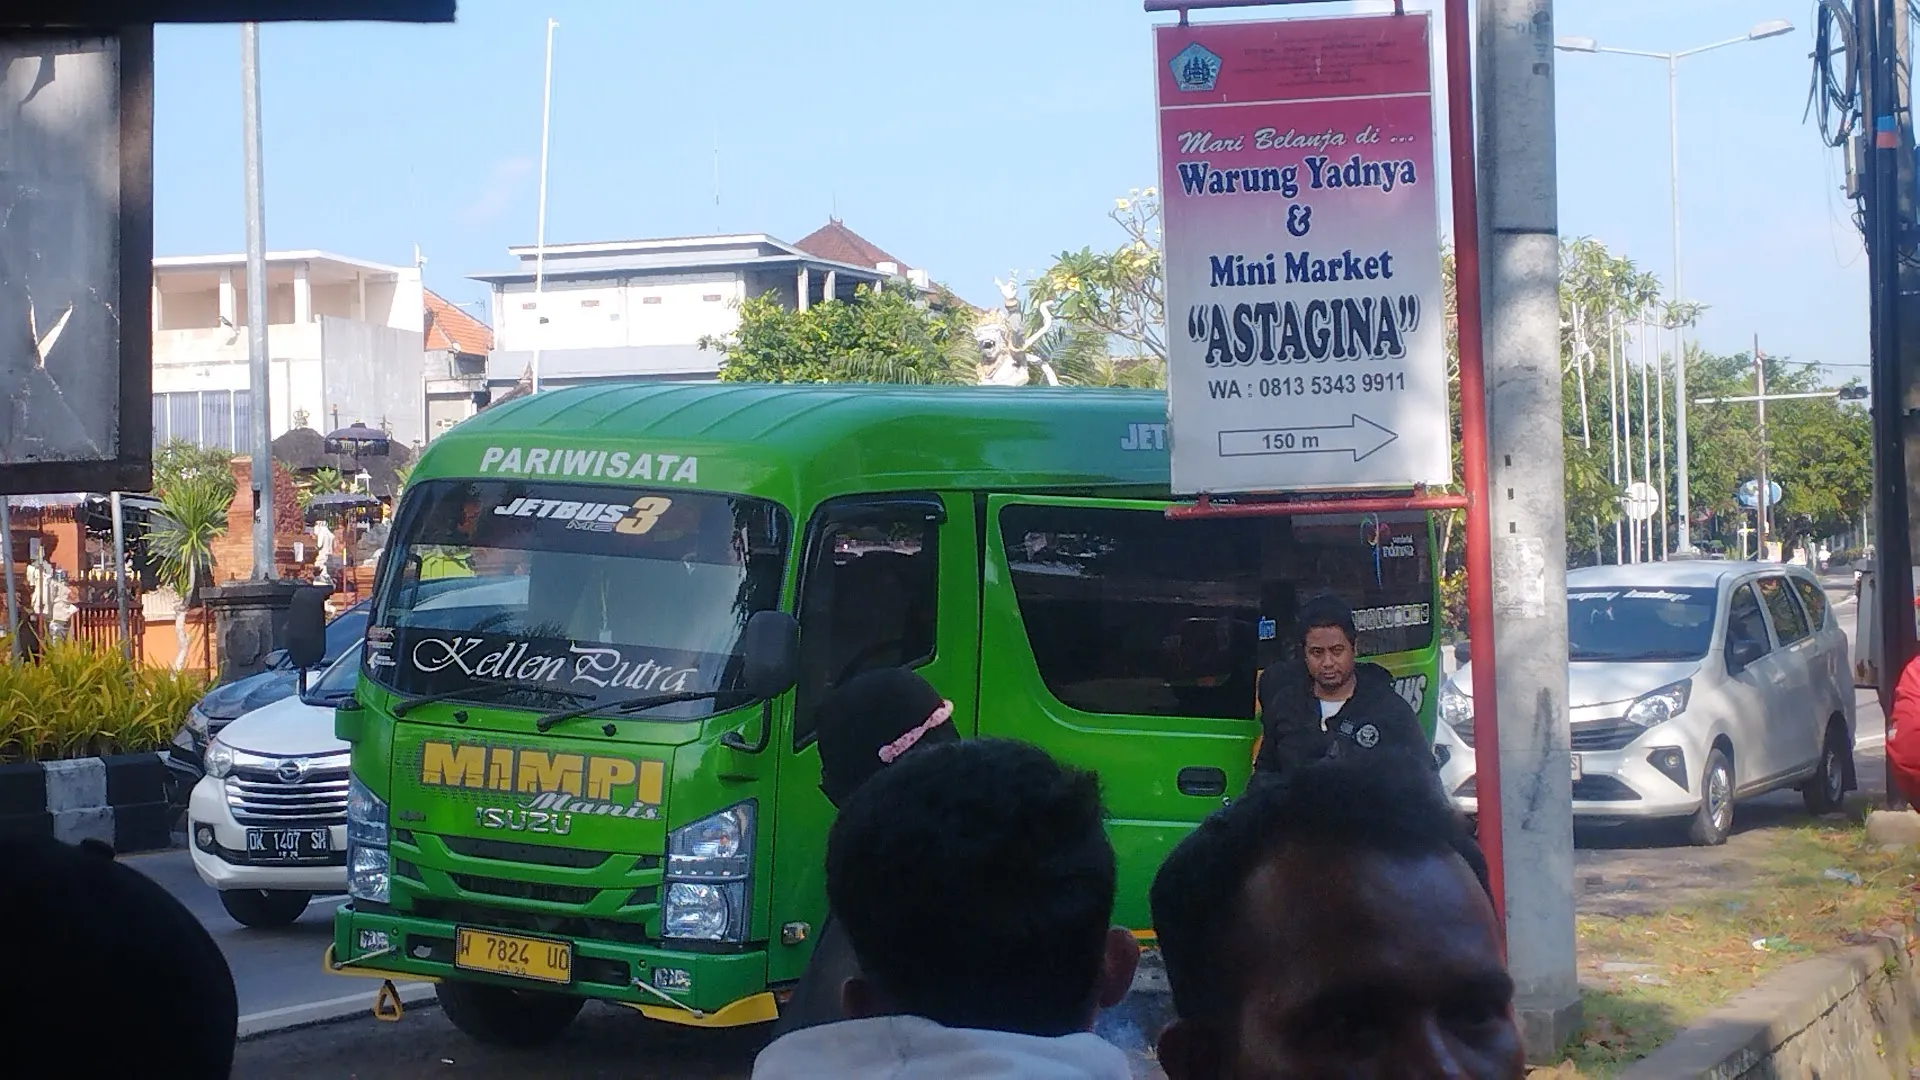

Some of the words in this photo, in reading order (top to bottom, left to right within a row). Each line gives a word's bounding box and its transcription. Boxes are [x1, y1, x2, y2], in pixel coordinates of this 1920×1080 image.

[1177, 132, 1244, 154] Mari
[1255, 128, 1346, 152] Belanja
[1355, 125, 1380, 144] di
[1178, 157, 1298, 198] Warung
[1304, 154, 1416, 192] Yadnya
[1286, 204, 1311, 236] &
[1210, 253, 1276, 287] Mini
[1285, 250, 1393, 283] Market
[1259, 378, 1304, 397] 0813
[1311, 375, 1355, 394] 5343
[1362, 372, 1405, 392] 9911
[1262, 433, 1294, 449] 150
[1302, 435, 1319, 447] m
[479, 447, 698, 483] PARIWISATA
[412, 636, 568, 682] Kellen
[475, 806, 571, 835] ISUZU
[273, 831, 301, 851] 1407
[311, 831, 327, 849] SH
[460, 934, 471, 957] W
[487, 937, 529, 965] 7824
